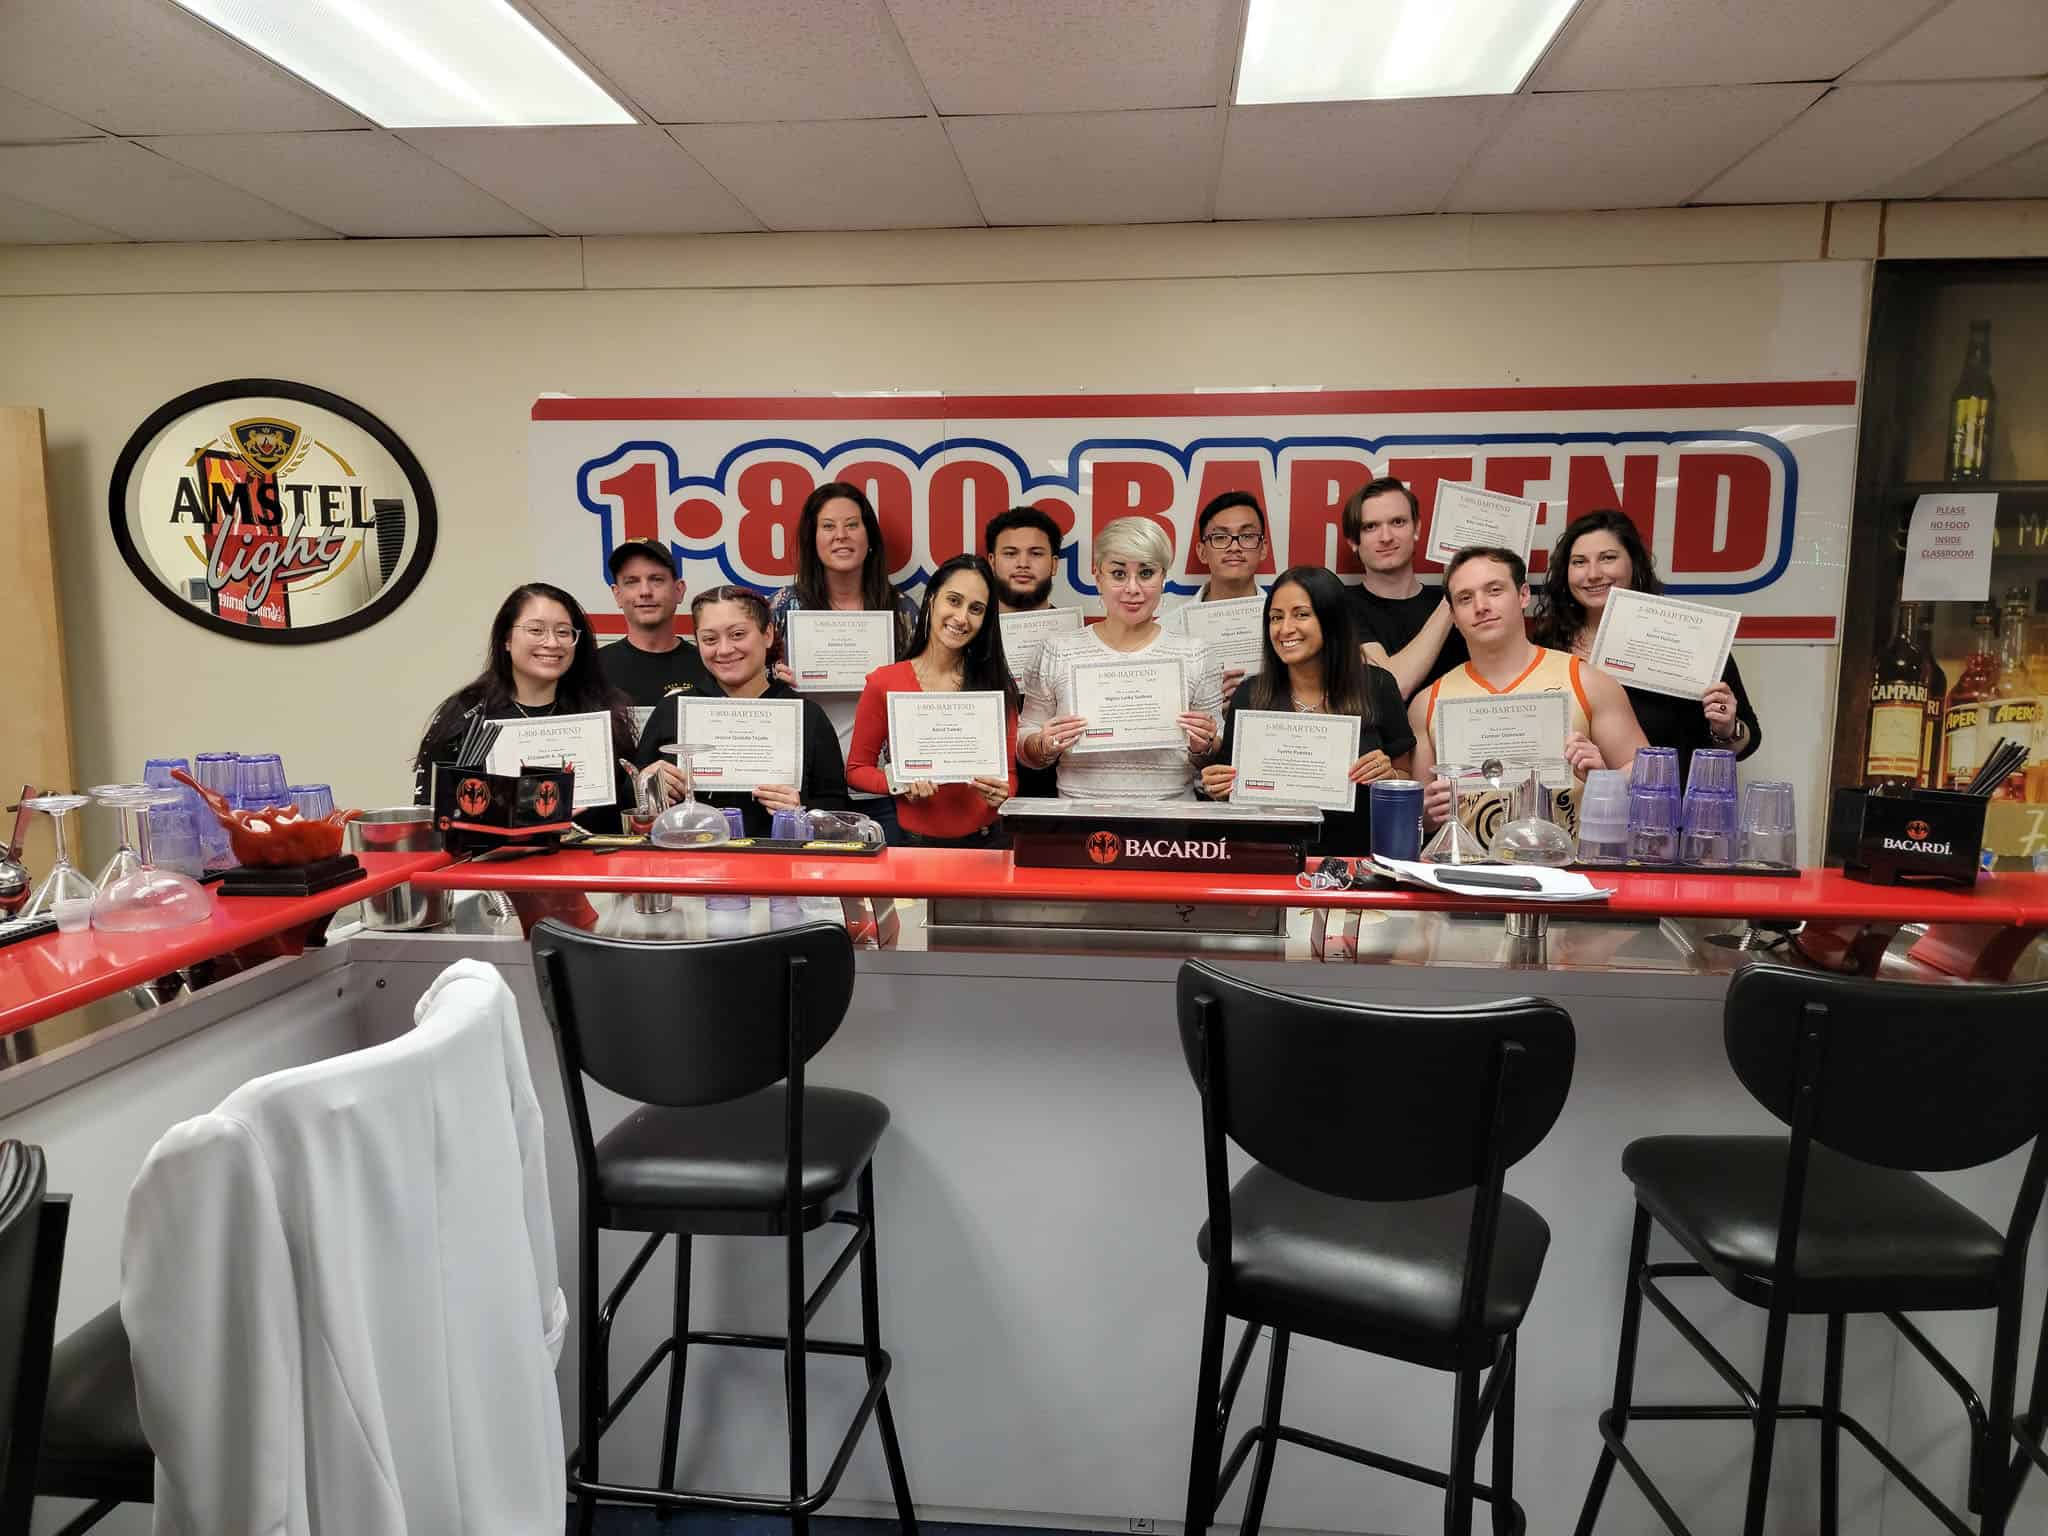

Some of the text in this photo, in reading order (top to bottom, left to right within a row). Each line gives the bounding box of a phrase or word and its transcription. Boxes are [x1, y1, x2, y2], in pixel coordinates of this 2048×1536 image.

[169, 476, 376, 529] AMSTEL
[1936, 506, 1967, 514] PLEASE
[1930, 521, 1970, 529] NO FOOD
[1935, 536, 1961, 544] INSIDE
[207, 513, 346, 612] light
[1871, 684, 1929, 700] CAMPARI
